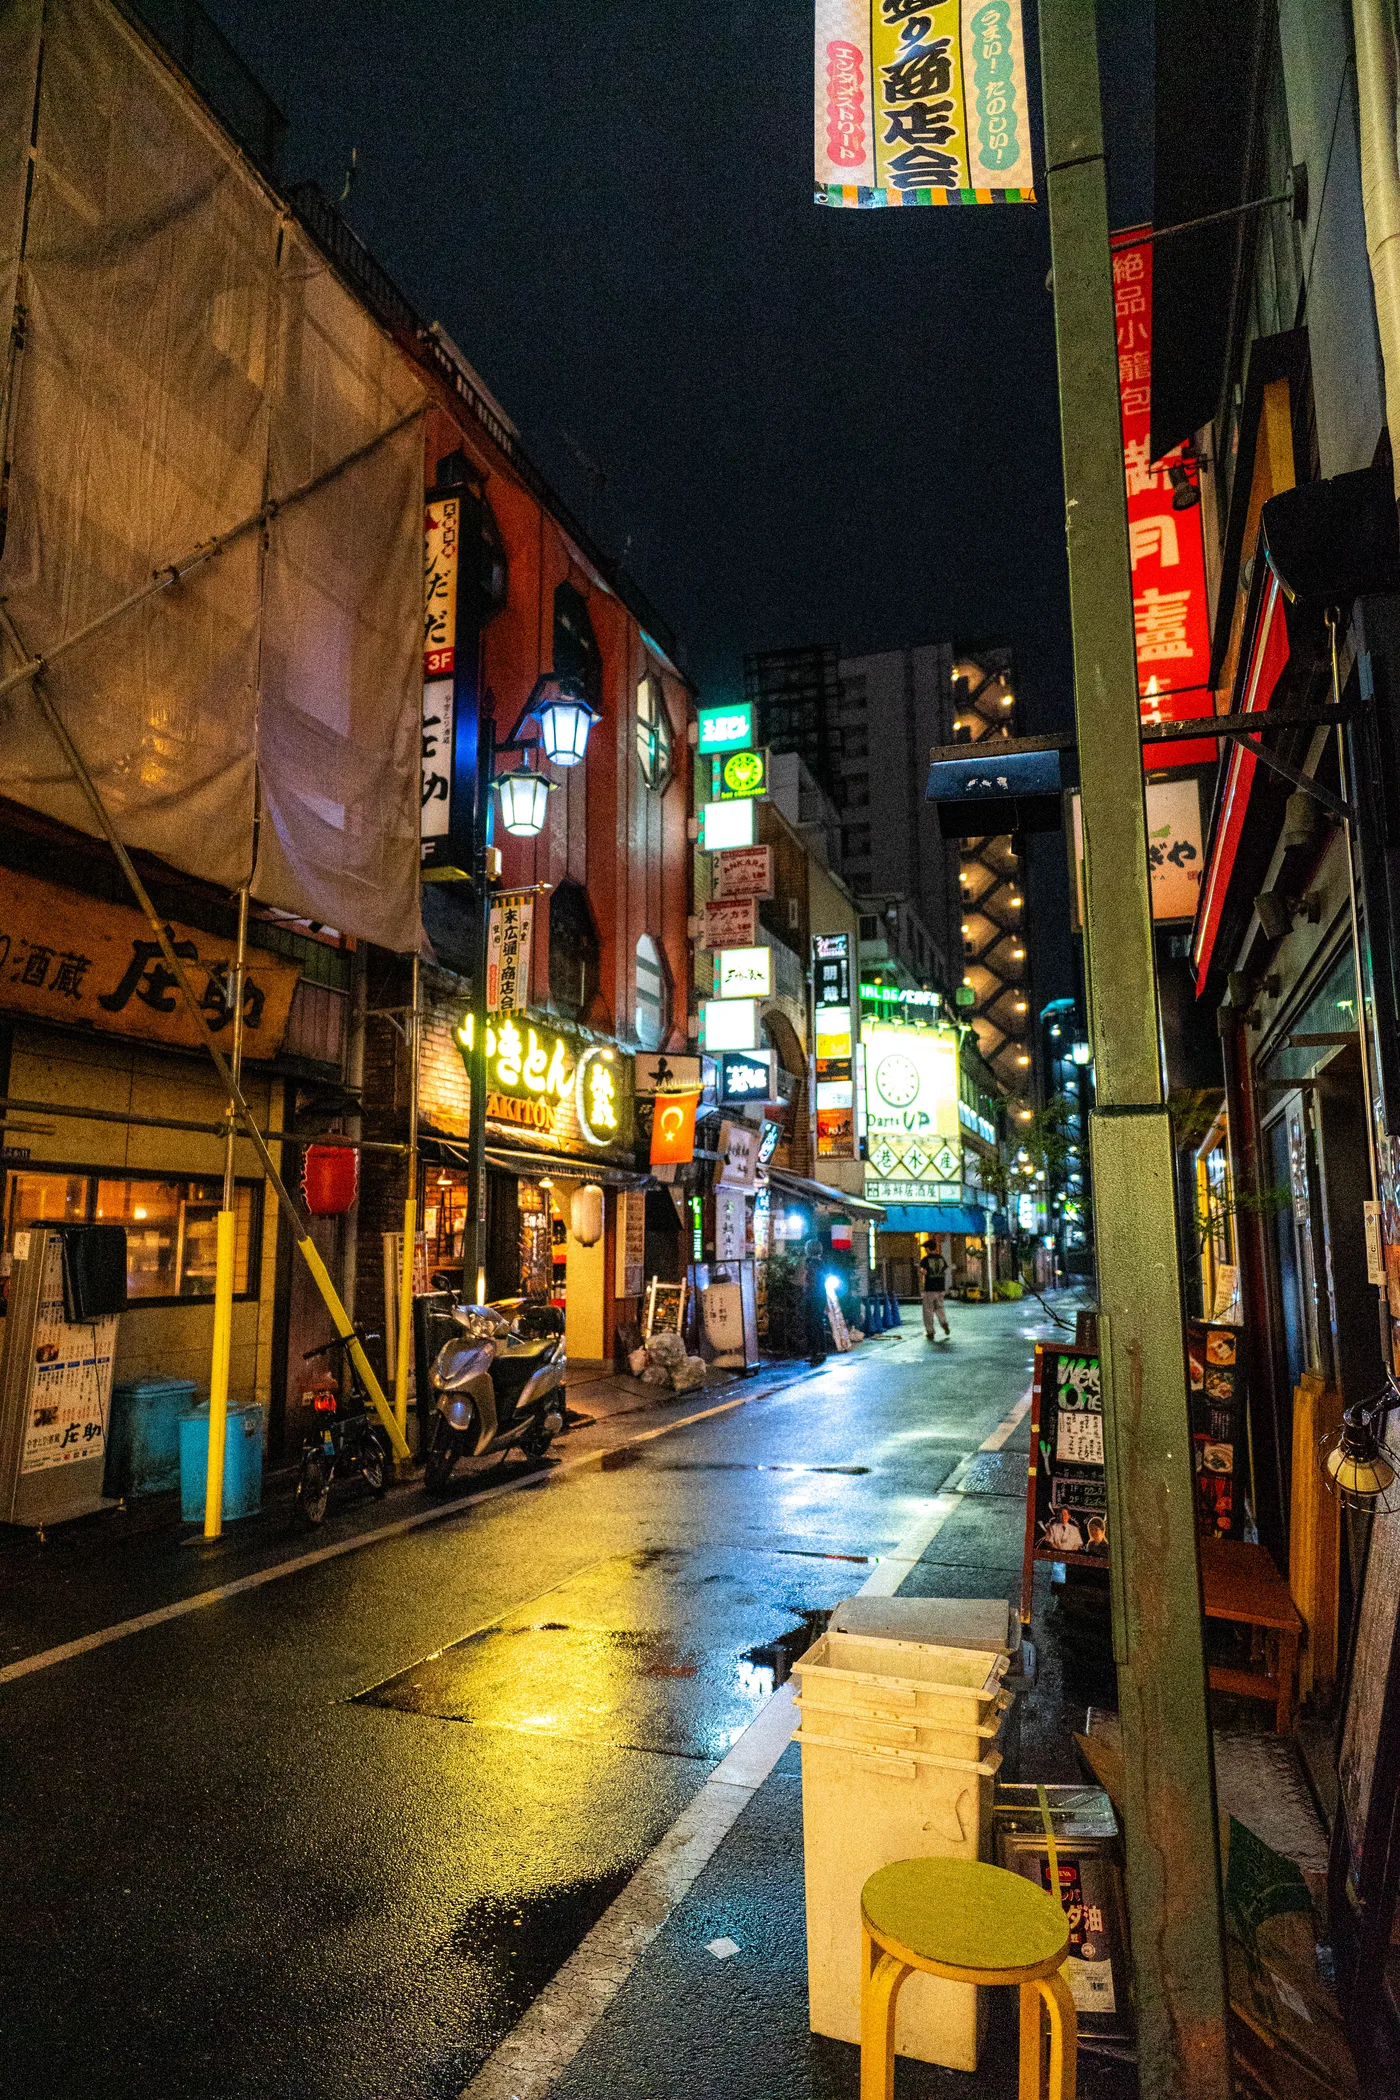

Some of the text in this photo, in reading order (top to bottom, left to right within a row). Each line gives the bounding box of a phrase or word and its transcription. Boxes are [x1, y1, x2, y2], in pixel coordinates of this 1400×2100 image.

[835, 47, 856, 159] エンタメストリート
[487, 1094, 557, 1129] AKITON
[903, 1110, 931, 1132] UP
[59, 1422, 102, 1448] 庄助
[1067, 1904, 1104, 1932] ダ油
